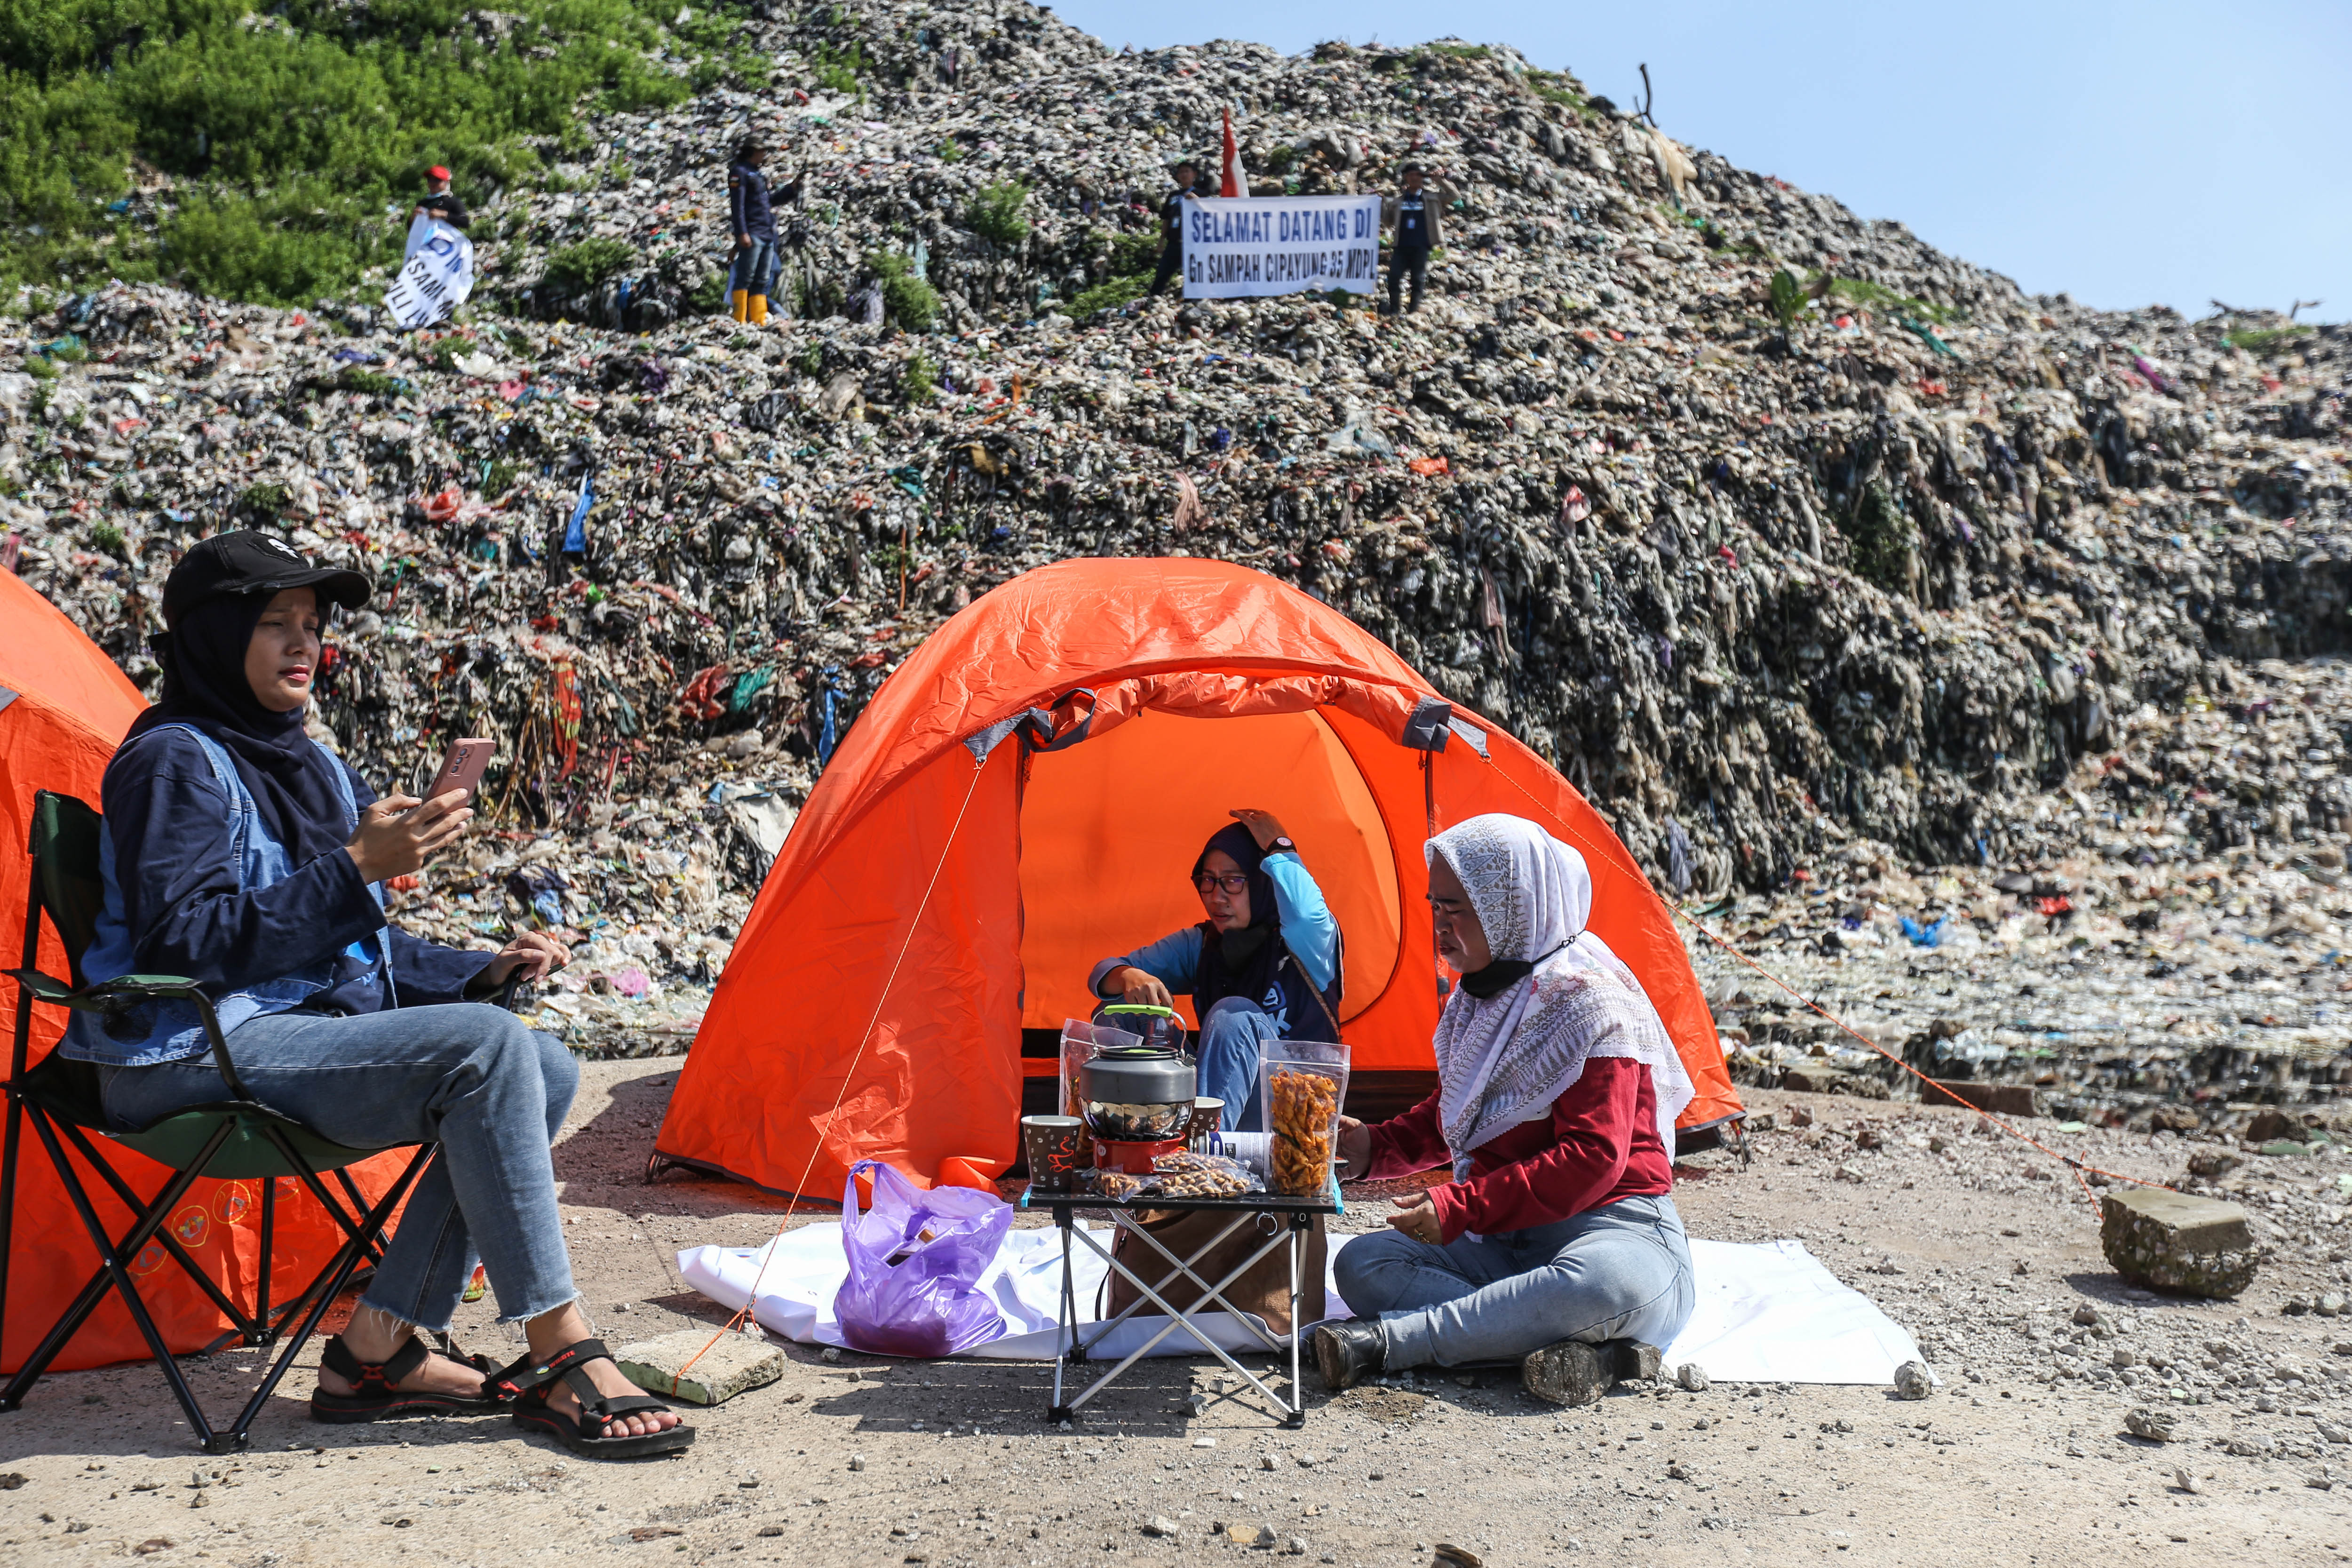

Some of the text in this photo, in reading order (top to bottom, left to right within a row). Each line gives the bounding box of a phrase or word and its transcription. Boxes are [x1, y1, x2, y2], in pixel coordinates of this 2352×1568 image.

[1192, 207, 1371, 243] SELAMAT DATANG DI
[1189, 248, 1375, 283] Gn SAMPAH CIPAYUNG 35 MDPL
